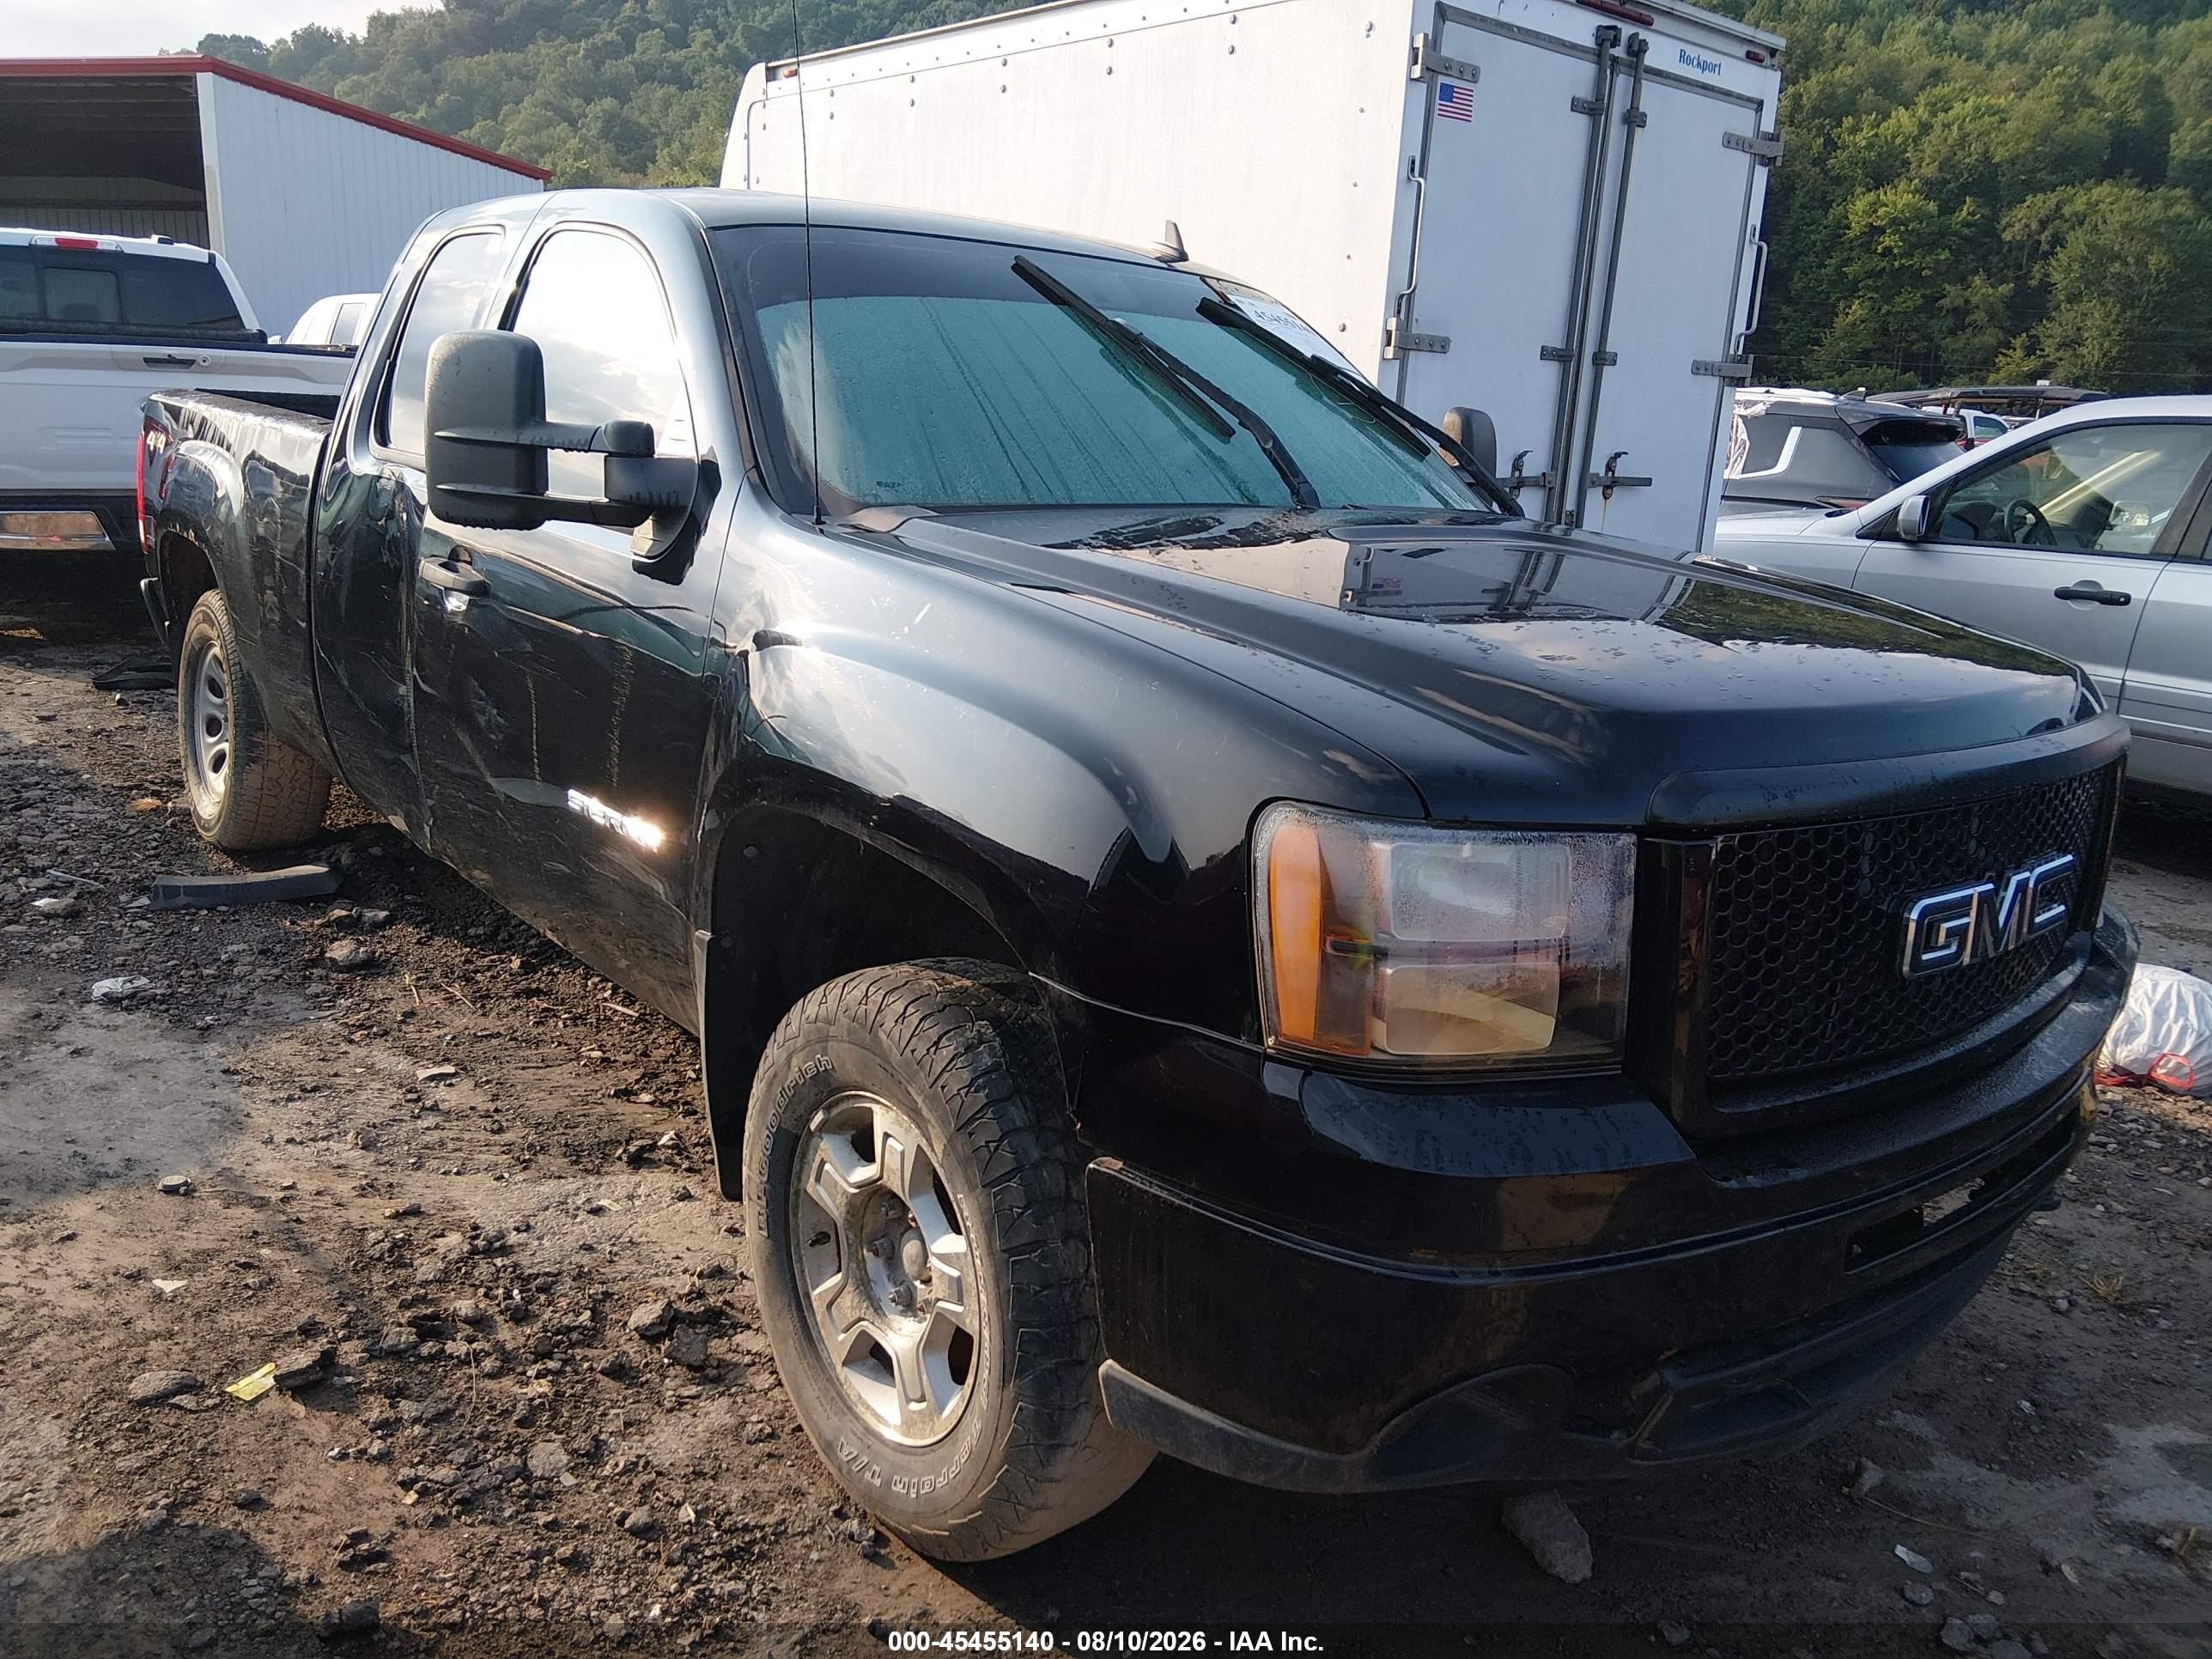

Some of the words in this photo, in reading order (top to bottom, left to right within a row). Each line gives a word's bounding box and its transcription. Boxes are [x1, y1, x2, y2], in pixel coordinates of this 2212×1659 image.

[1679, 48, 1723, 76] Rockport
[567, 788, 662, 854] SIER
[1902, 854, 2075, 979] GMC
[756, 1053, 835, 1238] BFGoodrich
[837, 1436, 883, 1488] T/A
[891, 1419, 983, 1498] Terrain
